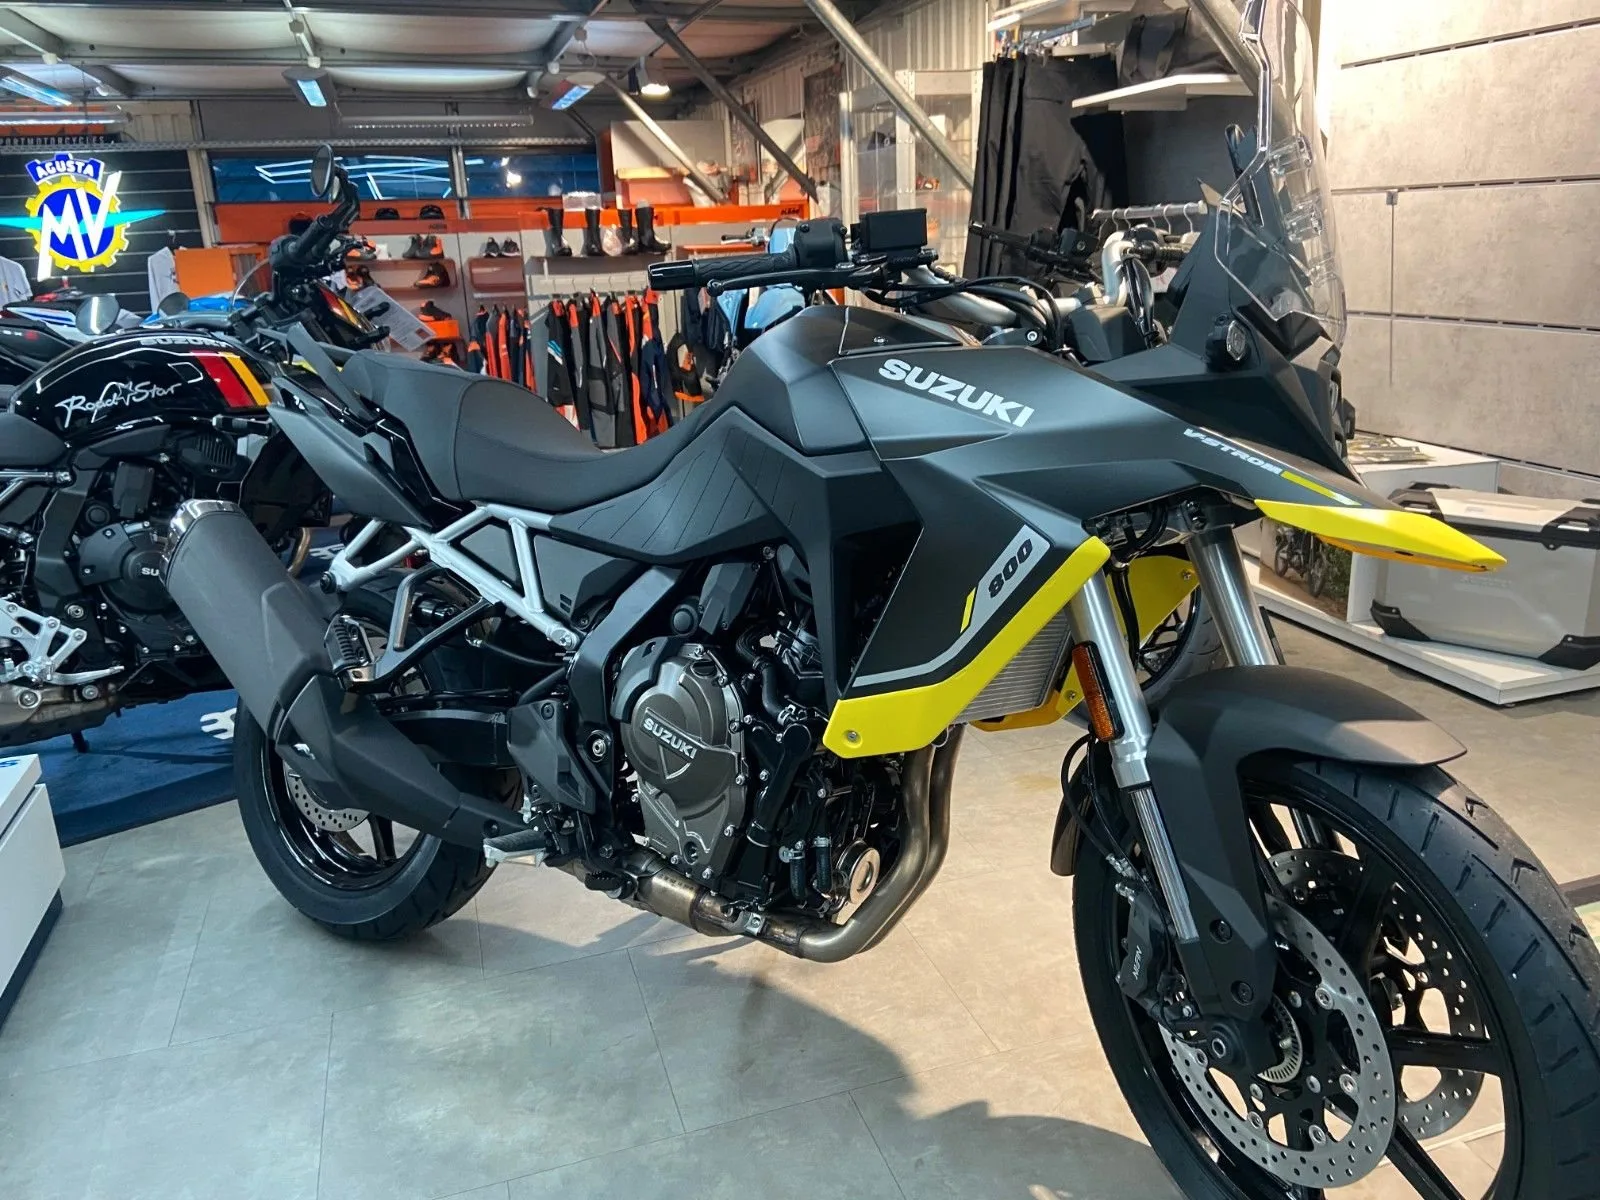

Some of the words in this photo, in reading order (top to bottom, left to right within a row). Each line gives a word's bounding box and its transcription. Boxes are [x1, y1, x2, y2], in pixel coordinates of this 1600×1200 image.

[35, 160, 95, 179] AGUSTA
[37, 170, 122, 282] MV
[878, 358, 1035, 428] SUZUKI
[988, 538, 1033, 598] 800
[643, 717, 697, 759] SUZUKI
